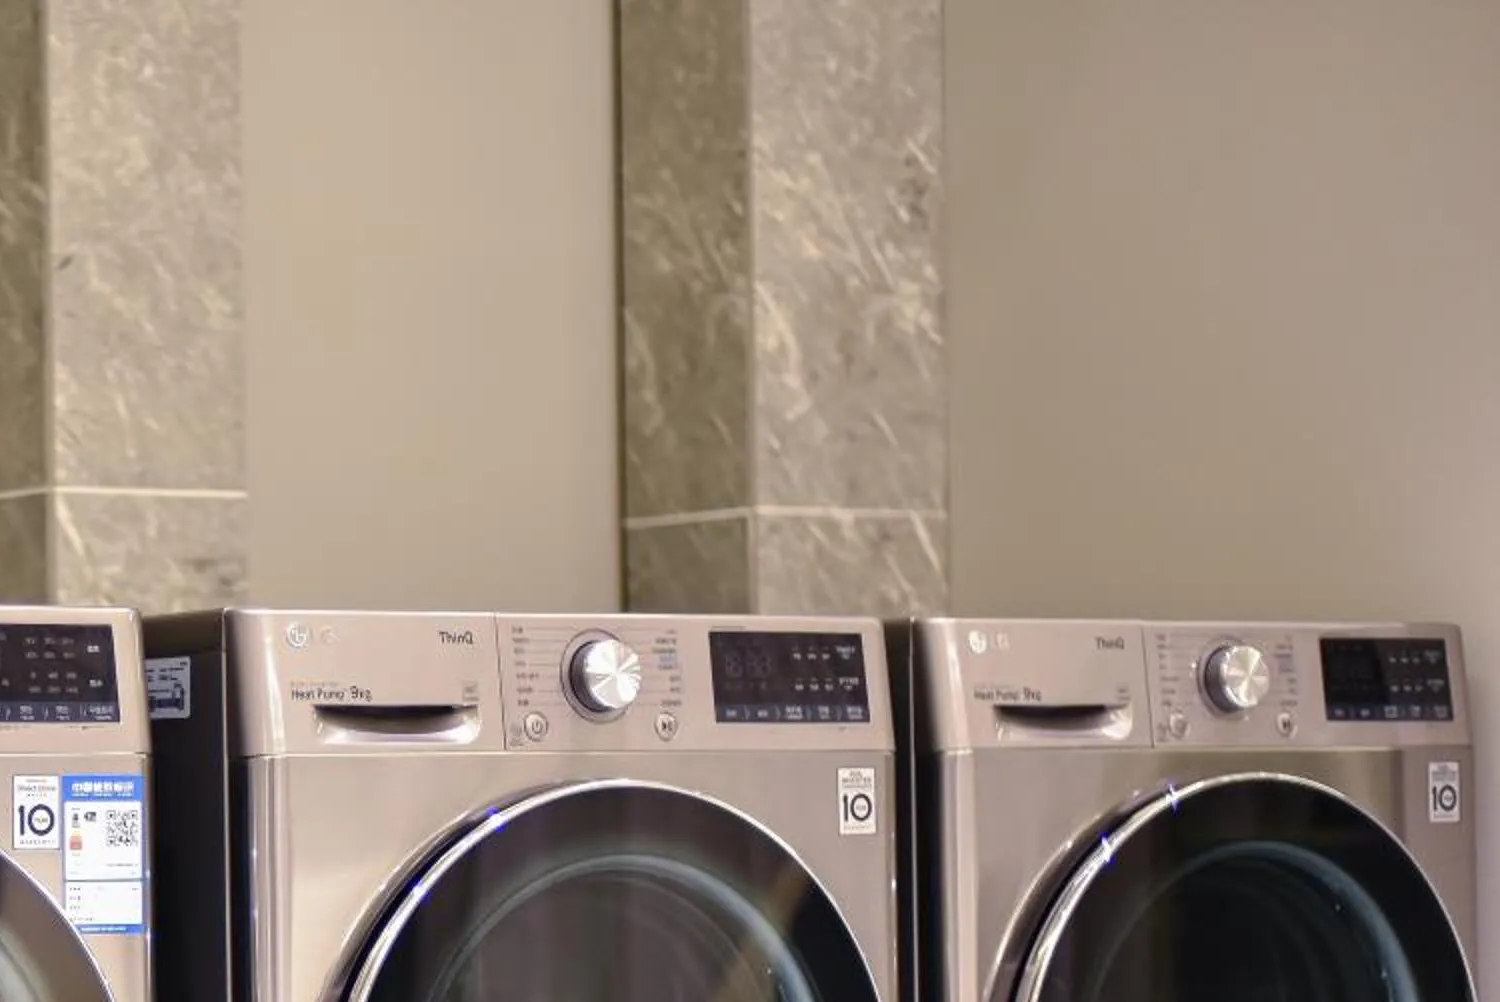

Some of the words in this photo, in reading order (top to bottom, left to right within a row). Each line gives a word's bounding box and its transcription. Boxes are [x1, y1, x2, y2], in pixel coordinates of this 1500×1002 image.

[843, 793, 873, 822] 10
[1431, 784, 1457, 812] 10
[19, 803, 55, 836] 10
